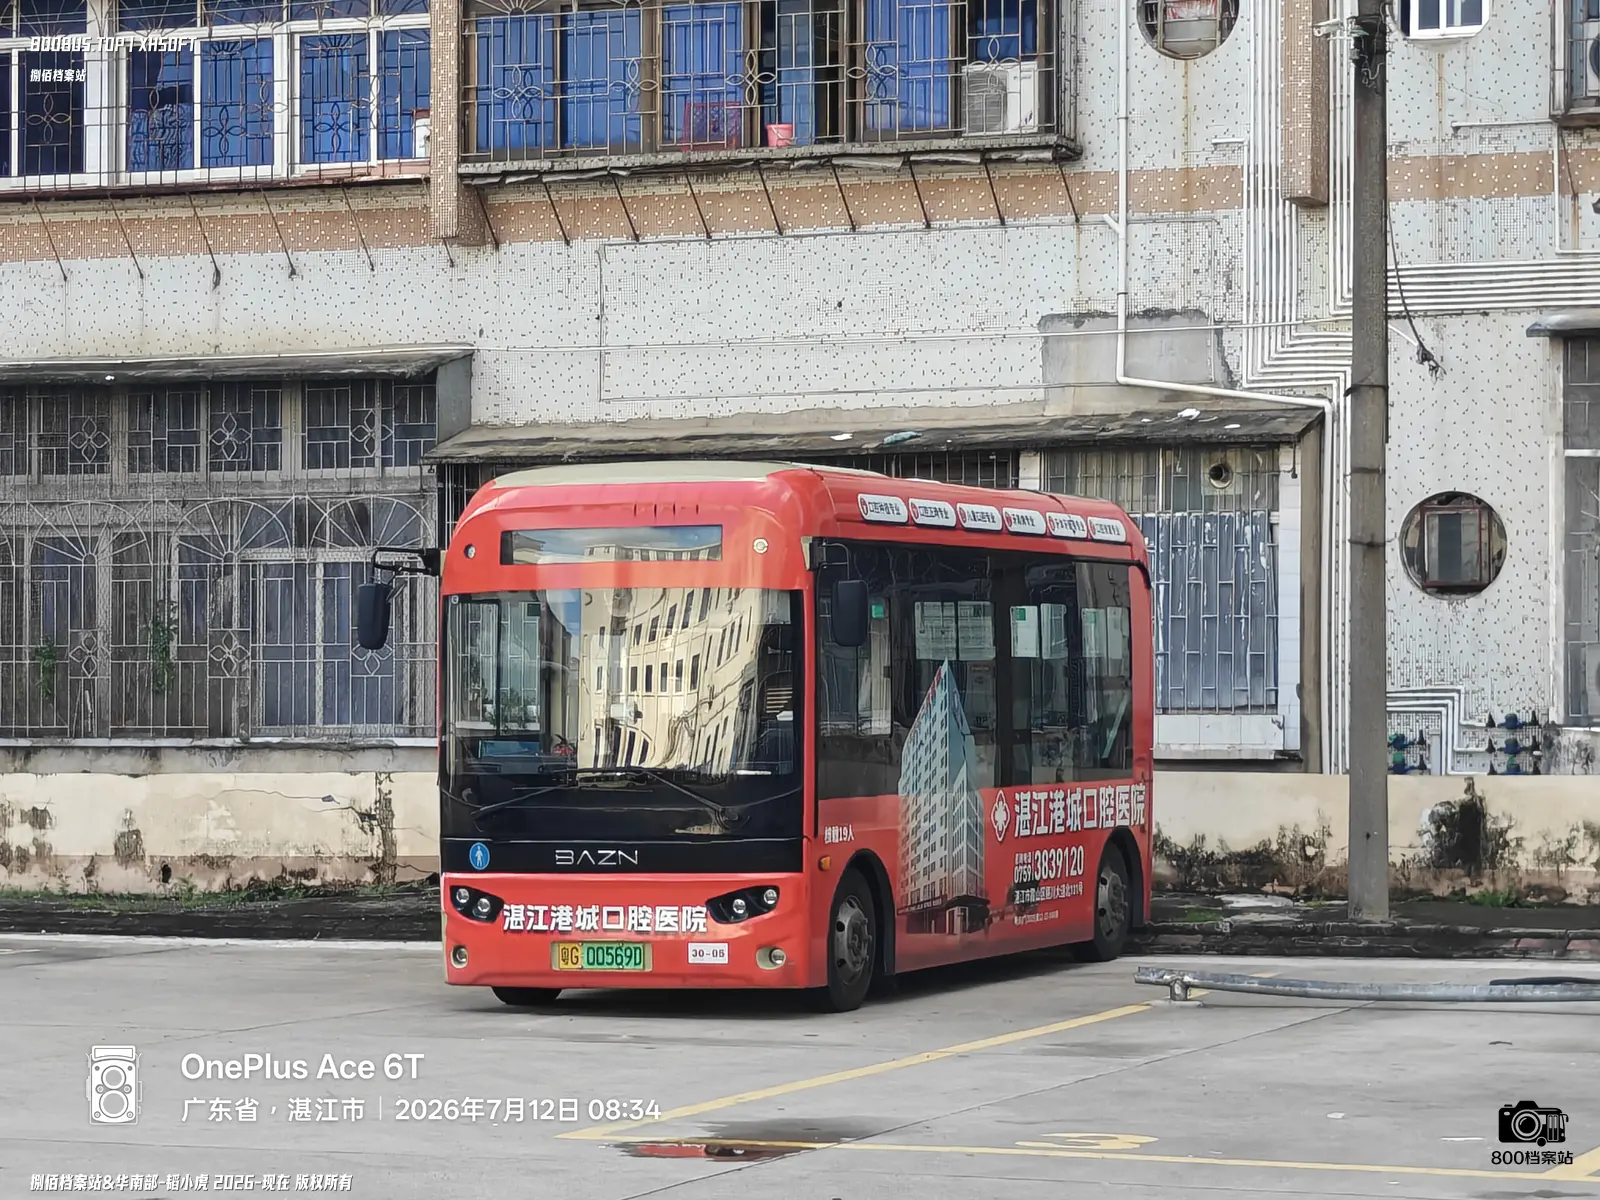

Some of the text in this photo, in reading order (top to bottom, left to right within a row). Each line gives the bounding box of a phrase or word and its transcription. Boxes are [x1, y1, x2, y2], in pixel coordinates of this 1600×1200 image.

[1014, 783, 1146, 838] 湛江港城口腔医院
[555, 849, 639, 865] BAZN
[1014, 865, 1032, 883] 0759
[1034, 845, 1084, 880] 3839120
[503, 904, 707, 933] 湛江港城口腔医院
